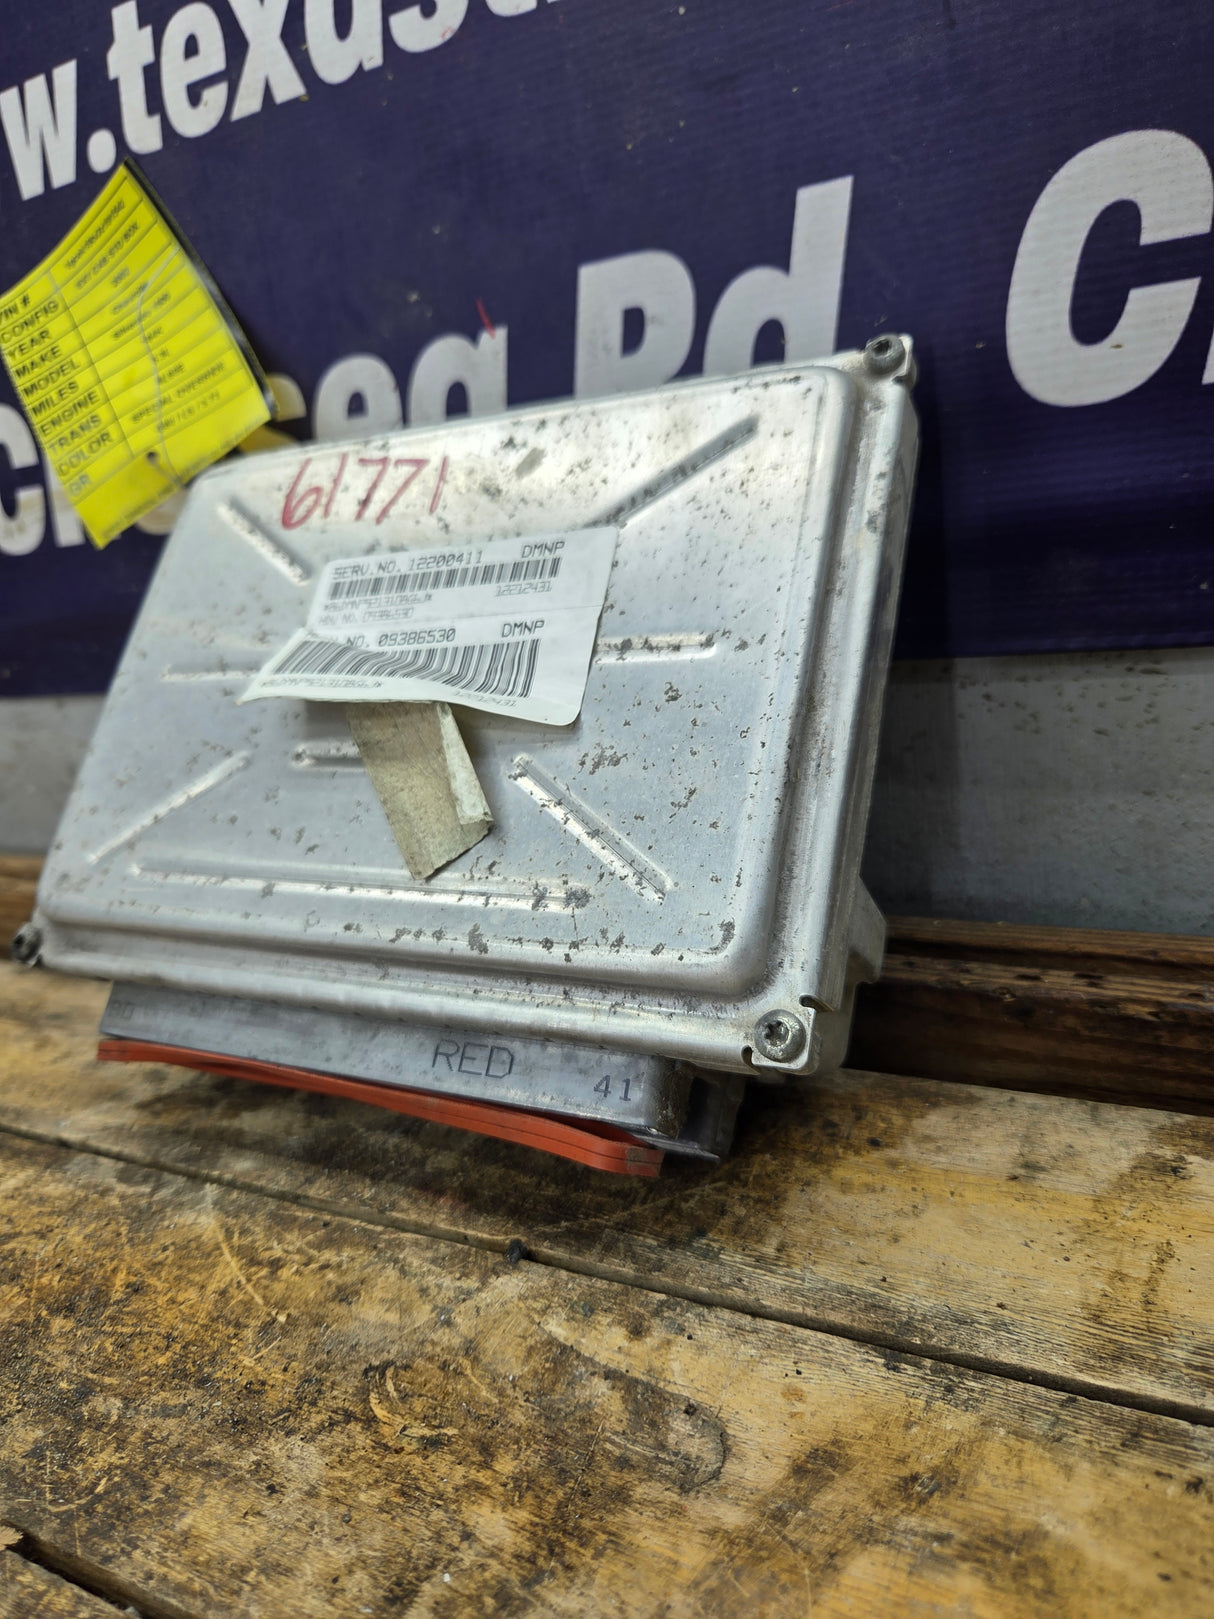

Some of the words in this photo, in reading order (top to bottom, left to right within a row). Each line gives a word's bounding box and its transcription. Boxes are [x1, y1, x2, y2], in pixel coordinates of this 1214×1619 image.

[1, 300, 59, 343] CONFIG
[8, 329, 50, 360] YEAR
[15, 345, 62, 378] MAKE
[23, 358, 81, 397] MODEL
[31, 380, 79, 416] MILES
[40, 390, 98, 435] ENGINE
[48, 414, 101, 455] TRANS
[58, 431, 113, 477] COLOR
[281, 453, 449, 531] 61771
[408, 550, 484, 571] 12200411
[521, 541, 566, 559] DMNP
[379, 628, 456, 648] 09386530
[501, 620, 545, 638] DMNP
[432, 1037, 514, 1079] RED
[593, 1074, 632, 1102] 41
